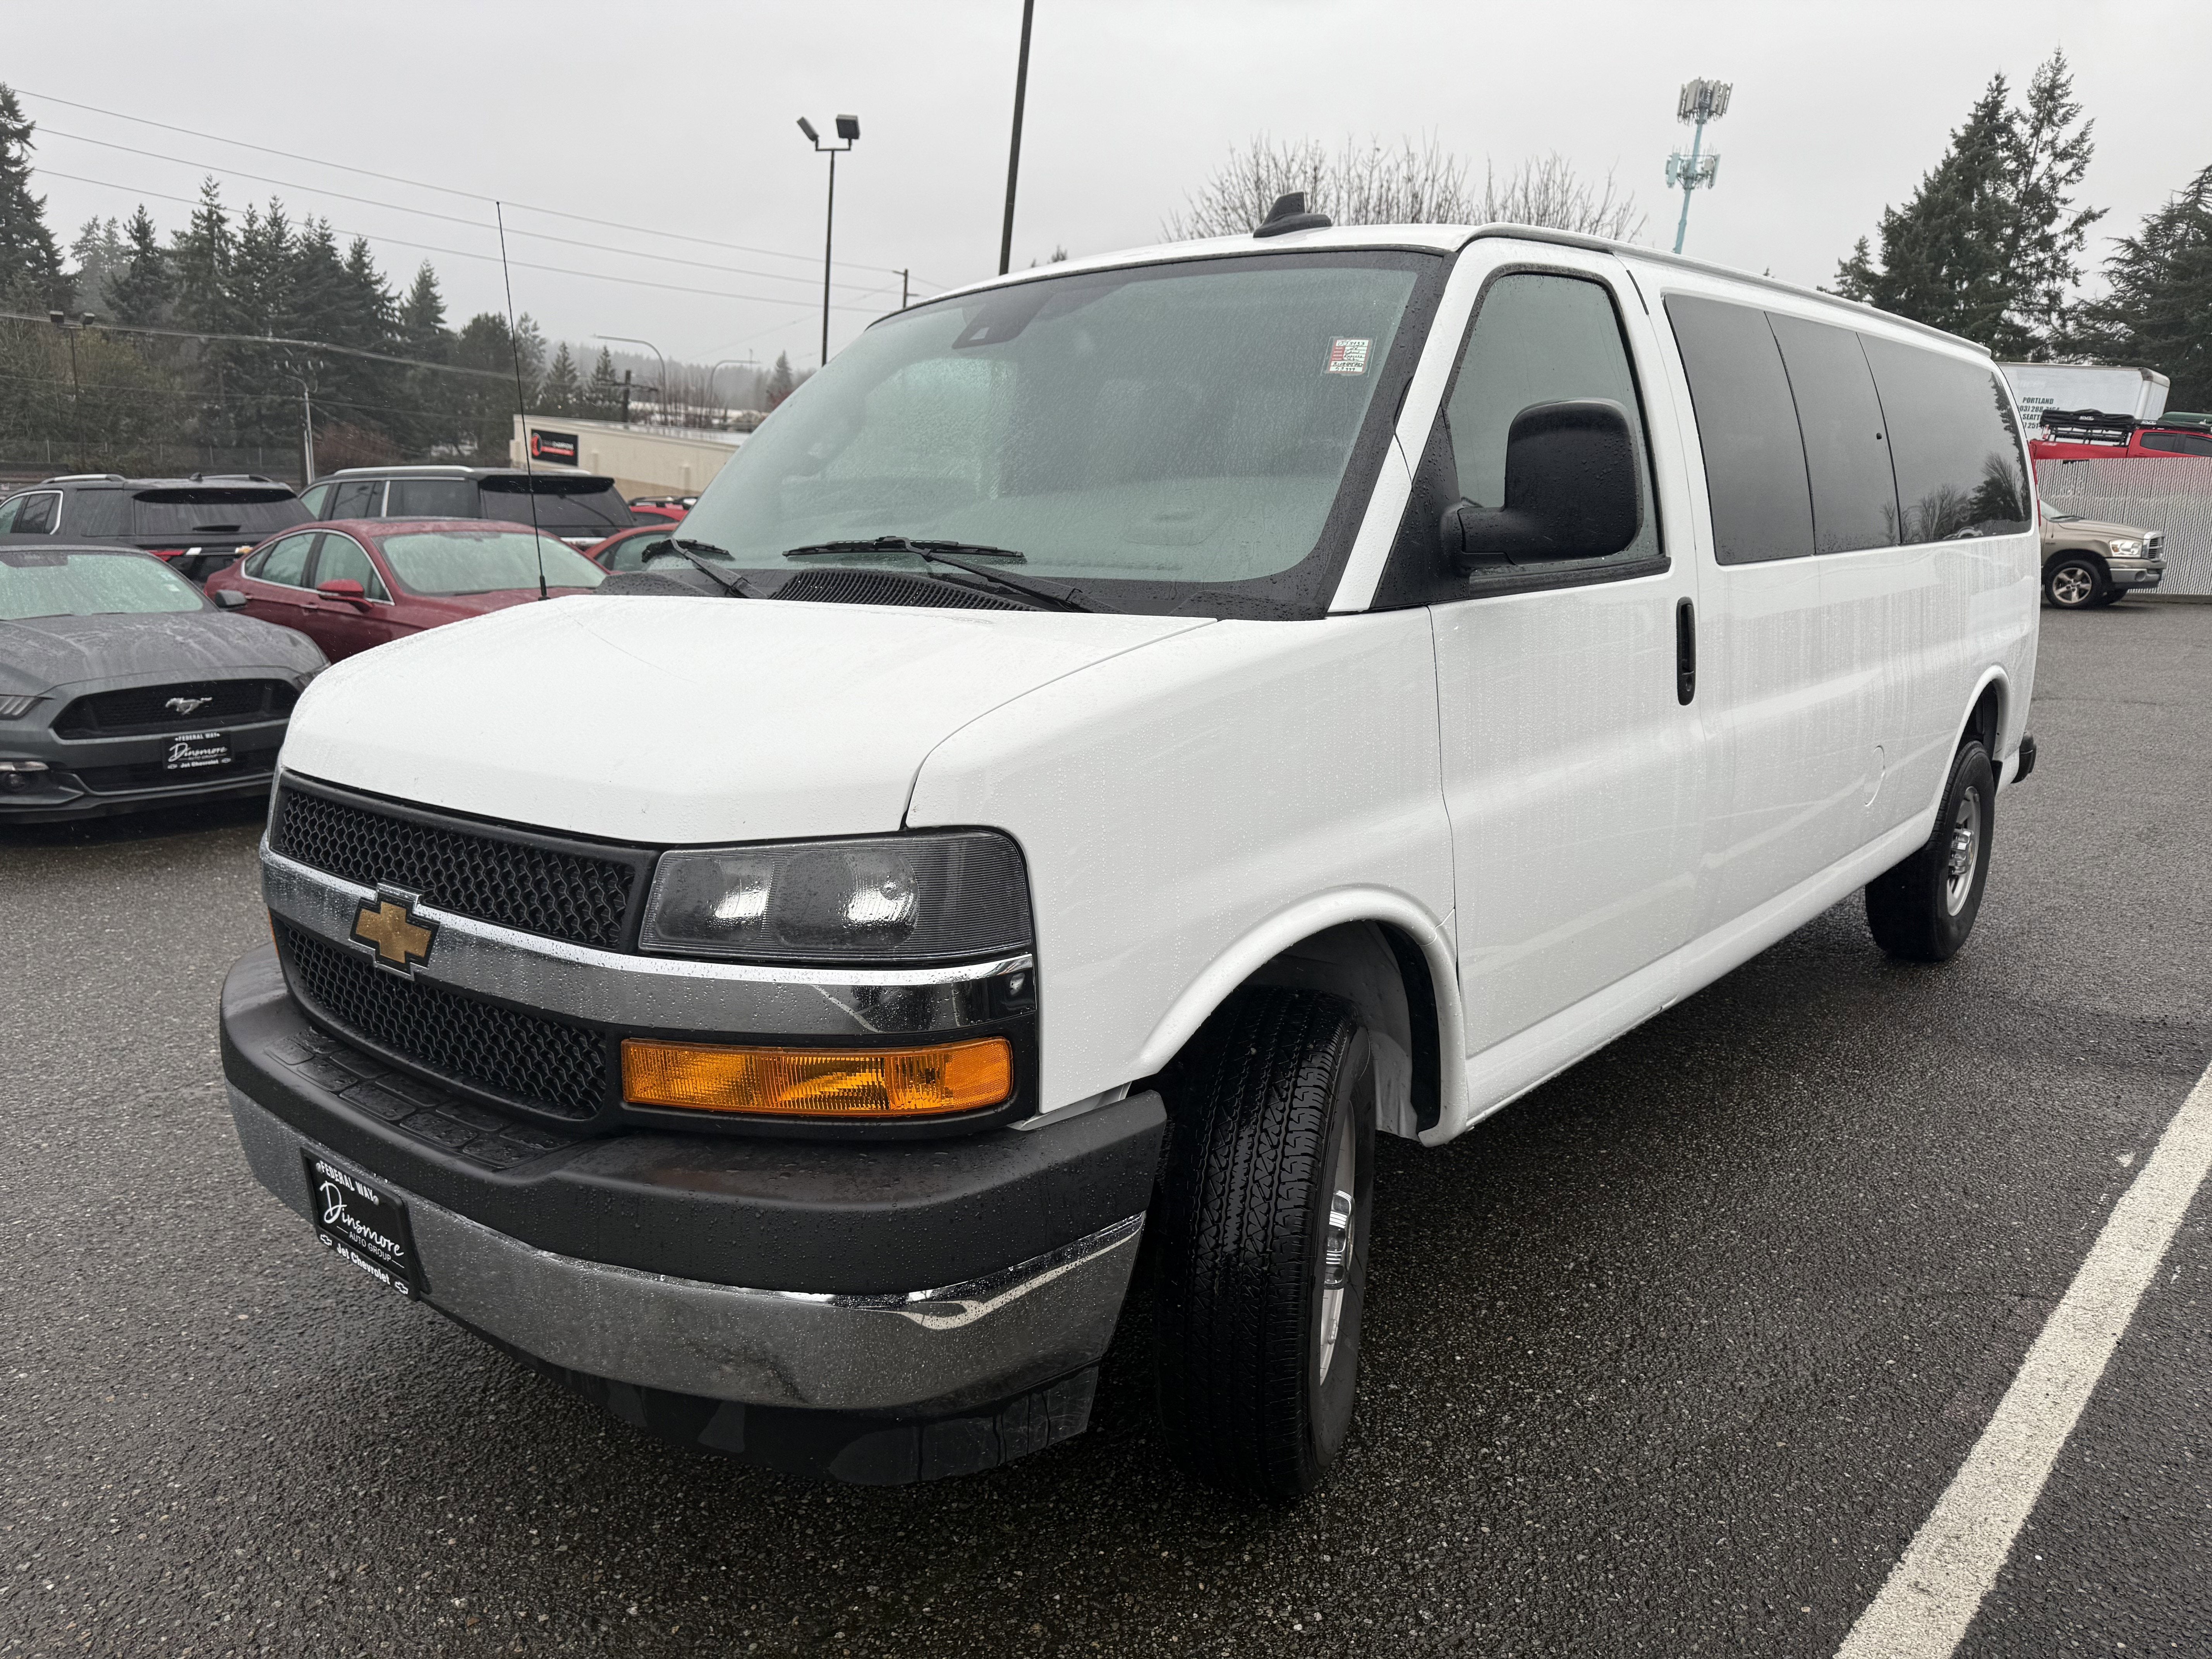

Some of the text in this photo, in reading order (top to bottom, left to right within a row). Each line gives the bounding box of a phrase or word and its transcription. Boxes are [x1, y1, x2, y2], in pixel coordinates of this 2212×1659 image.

[168, 742, 228, 762] Dinsmore
[320, 1160, 374, 1201] FEDERAL WAY
[319, 1180, 405, 1256] Dinsmore
[337, 1243, 391, 1285] Jet Chevrolet
[349, 1231, 391, 1262] AUTO GROUP
